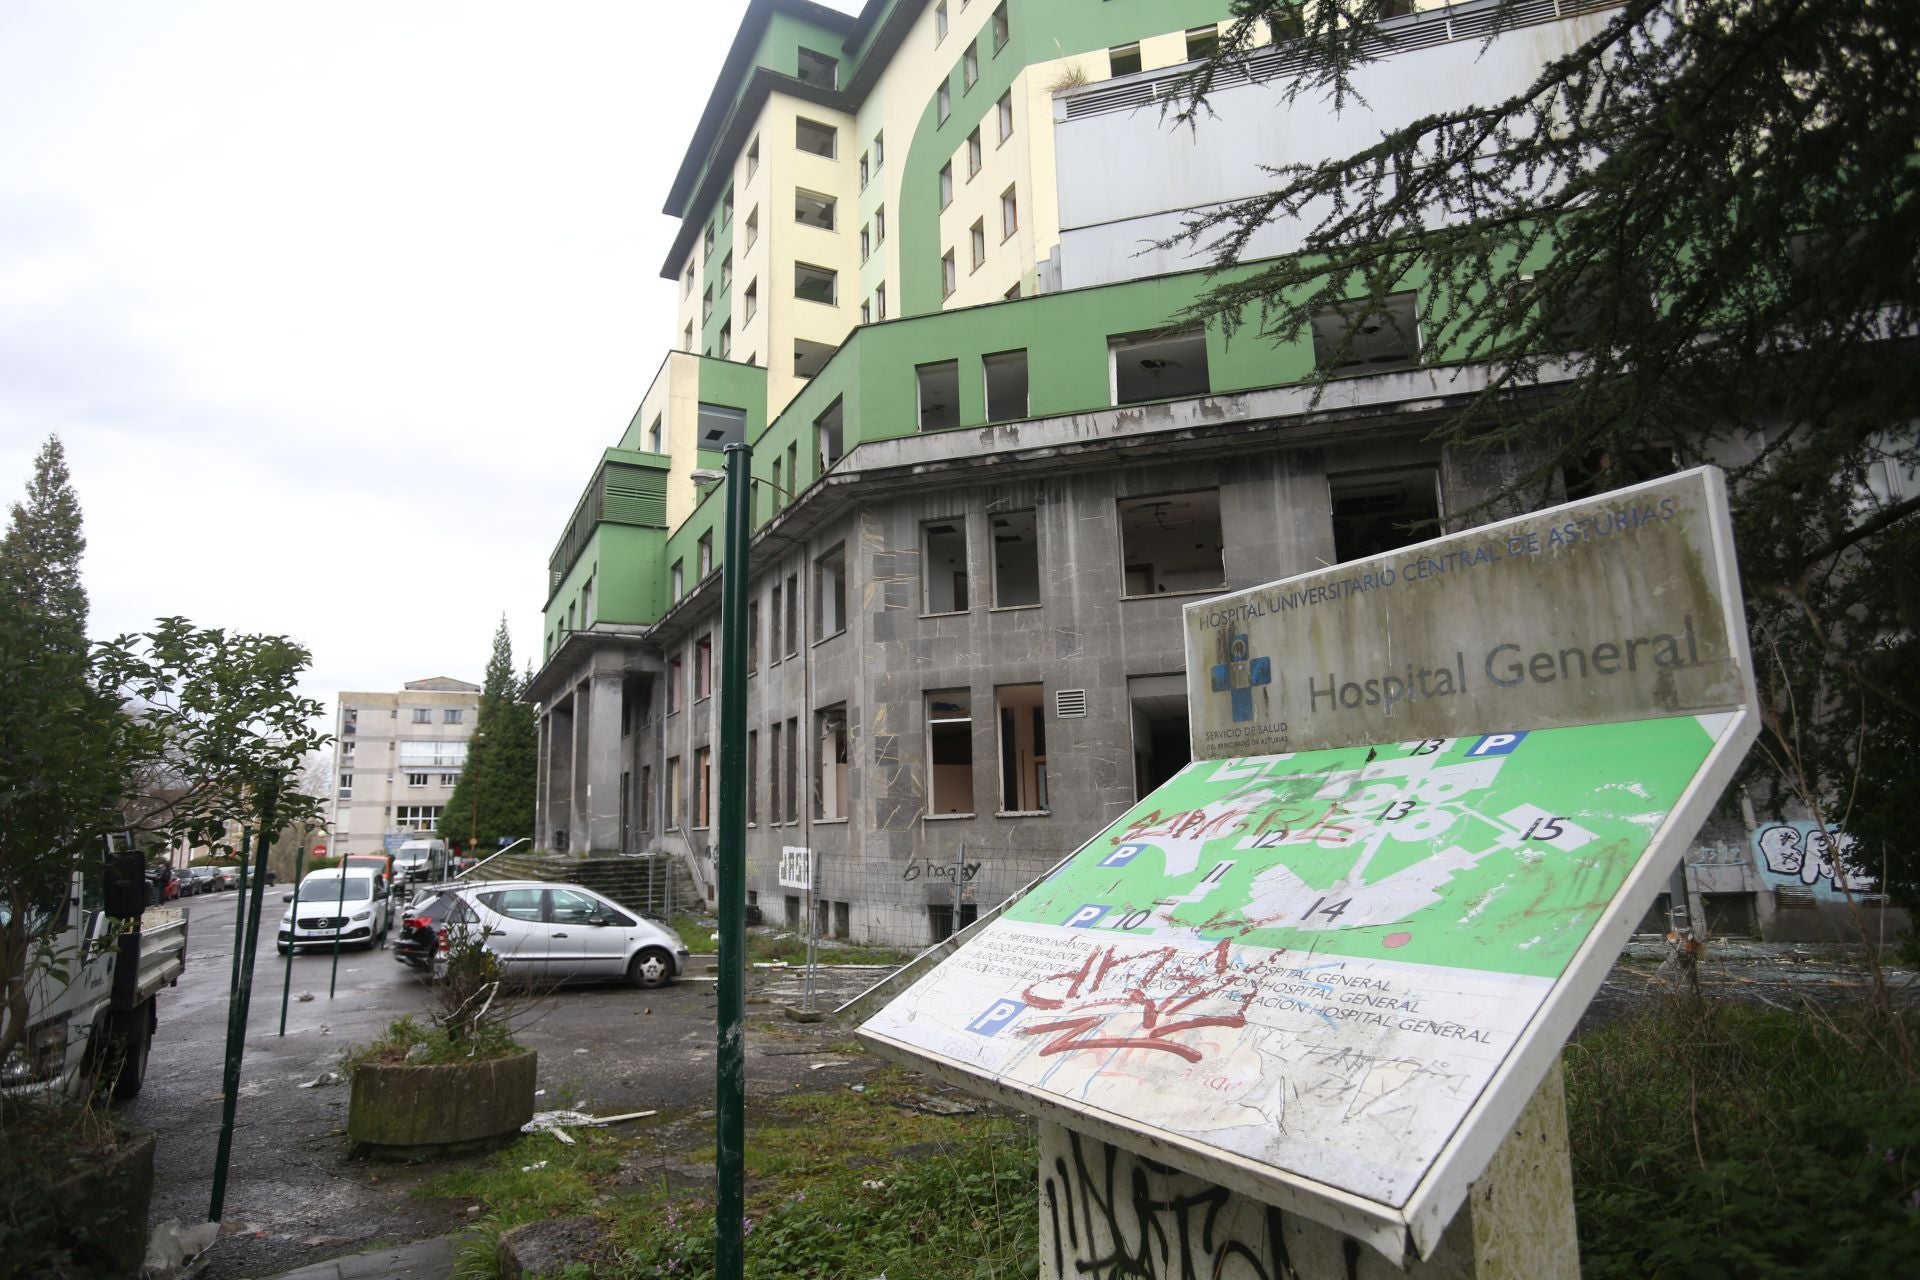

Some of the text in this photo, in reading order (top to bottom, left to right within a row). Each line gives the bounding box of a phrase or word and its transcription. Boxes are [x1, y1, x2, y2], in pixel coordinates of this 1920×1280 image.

[1199, 499, 1675, 630] HOSPITAL UNIVERSITARIO CENTRAL DE ASTURIAS
[1309, 614, 1699, 716] Hospital General
[1206, 728, 1242, 741] SERVICIO
[1258, 722, 1288, 735] SALUD
[1410, 738, 1445, 756] 13
[1473, 734, 1517, 755] P
[1376, 800, 1417, 821] 13
[1250, 829, 1287, 849] 12
[1520, 816, 1572, 841] 15
[1103, 846, 1138, 866] P
[1199, 863, 1234, 883] 11
[1064, 905, 1102, 927] P
[1111, 909, 1151, 931] 10
[1300, 896, 1352, 923] 14
[984, 942, 1022, 953] BLOQUE
[1009, 932, 1050, 945] MATERNO
[976, 951, 1010, 963] BLOQUE
[1316, 972, 1391, 992] GENERAL
[1259, 979, 1332, 1001] HOSPITAL
[1339, 992, 1420, 1013] GENERAL
[973, 1002, 1017, 1030] P
[1310, 1003, 1393, 1028] HOSPITAL
[1398, 1017, 1492, 1044] GENERAL
